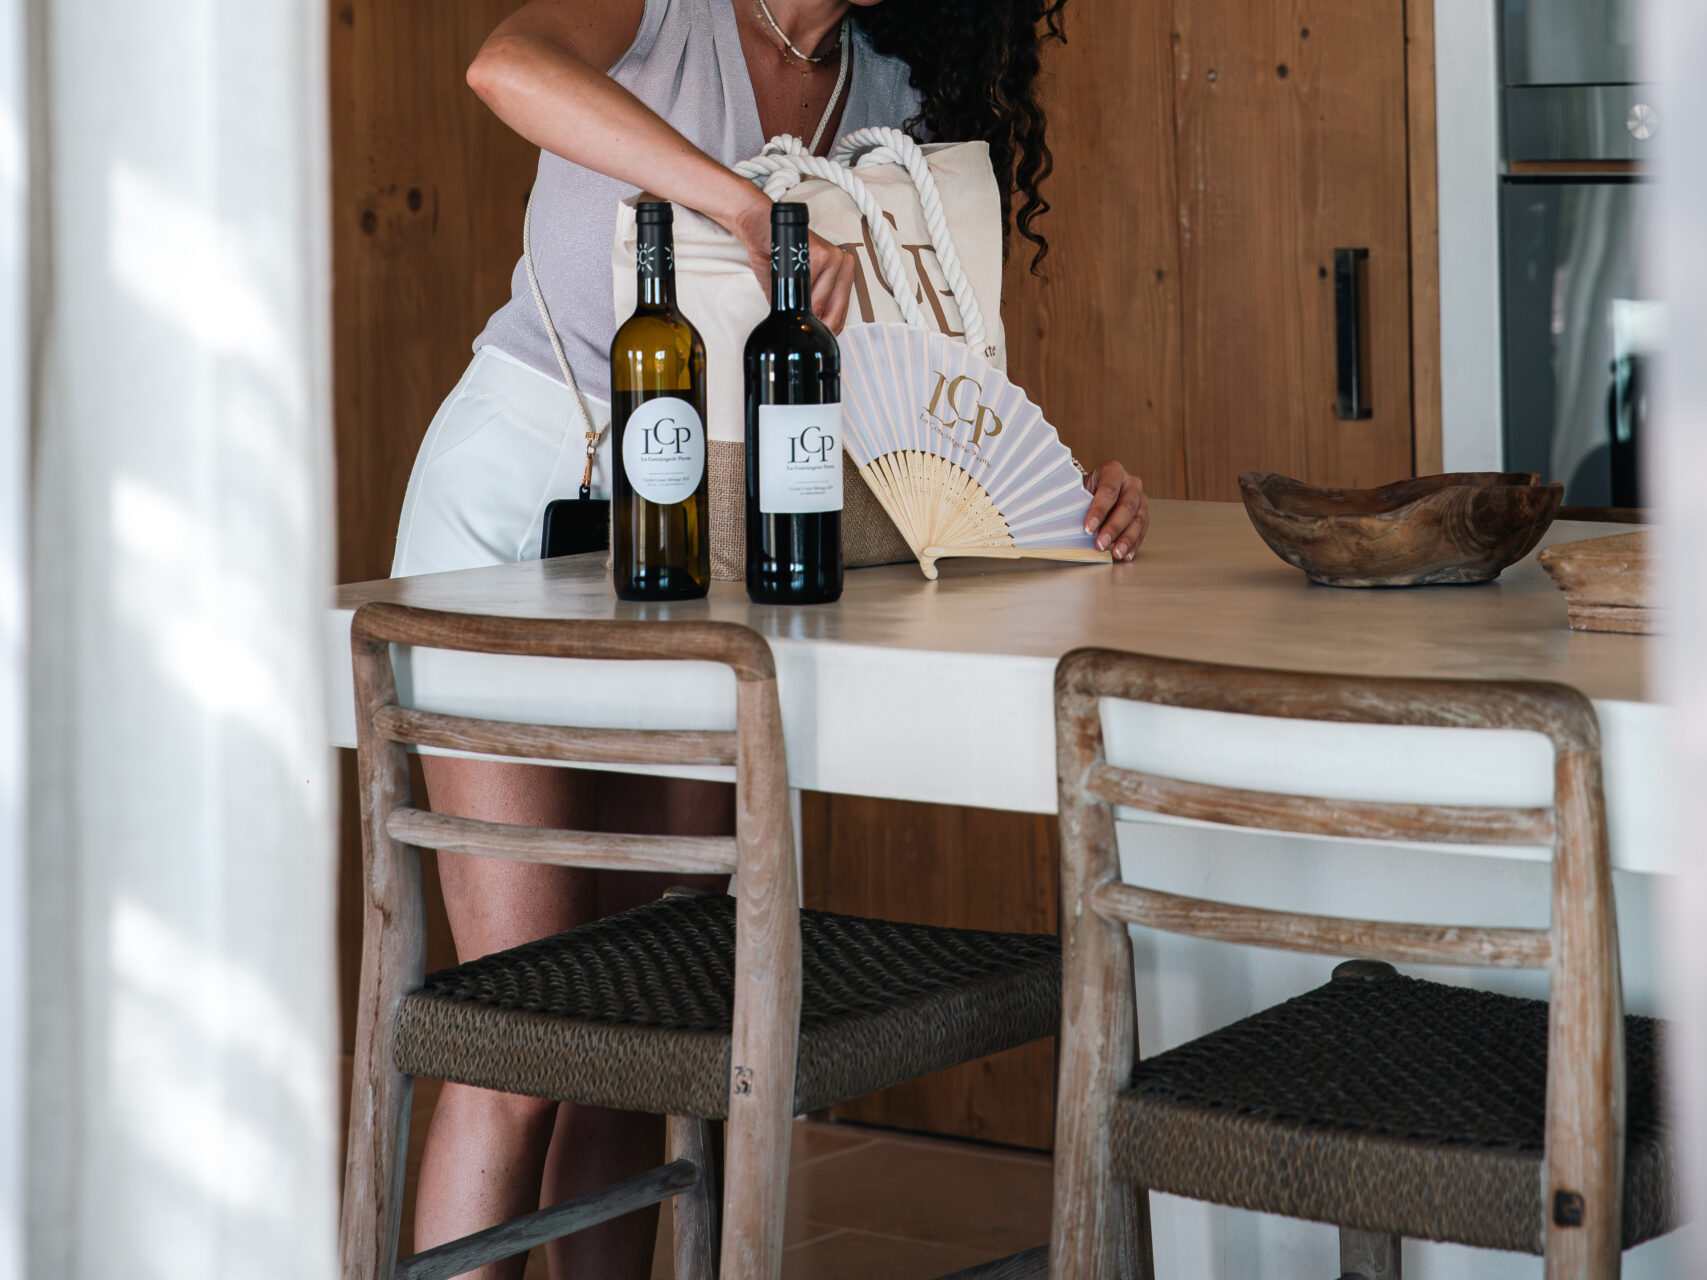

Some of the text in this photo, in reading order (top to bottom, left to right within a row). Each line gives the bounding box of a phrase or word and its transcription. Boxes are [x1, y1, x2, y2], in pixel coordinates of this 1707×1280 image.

[924, 370, 1003, 449] LCP
[641, 418, 691, 455] LCP
[787, 426, 835, 464] LCP
